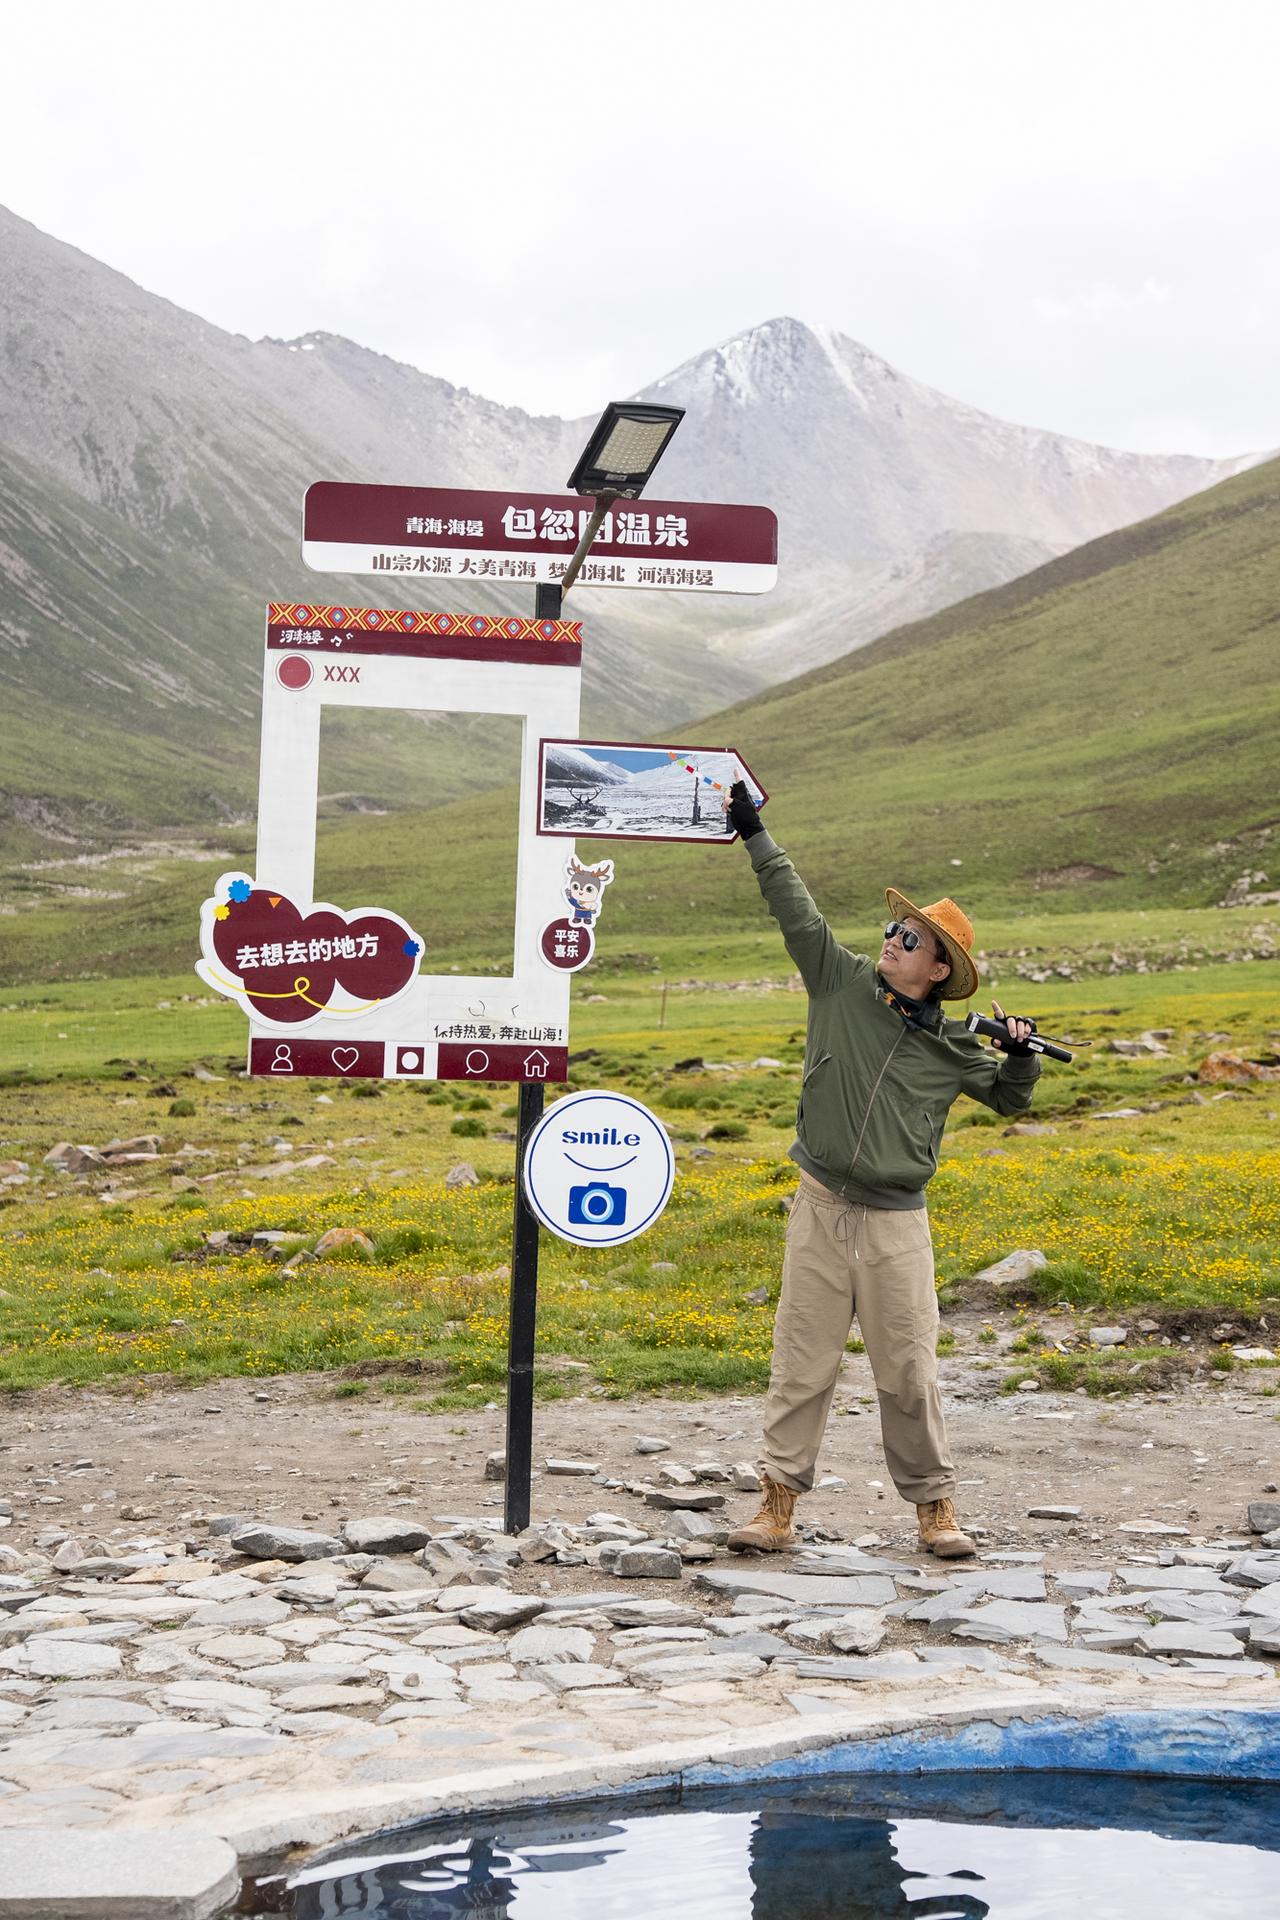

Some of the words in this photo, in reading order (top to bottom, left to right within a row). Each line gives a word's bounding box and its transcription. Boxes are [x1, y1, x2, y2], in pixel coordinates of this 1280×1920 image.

[372, 553, 452, 574] 山宗水源
[458, 557, 537, 578] 大美青海
[323, 665, 361, 683] XXX
[554, 929, 580, 943] 平安
[235, 933, 380, 970] 去想去的地方
[553, 944, 579, 958] 喜乐
[561, 1128, 641, 1147] smile
